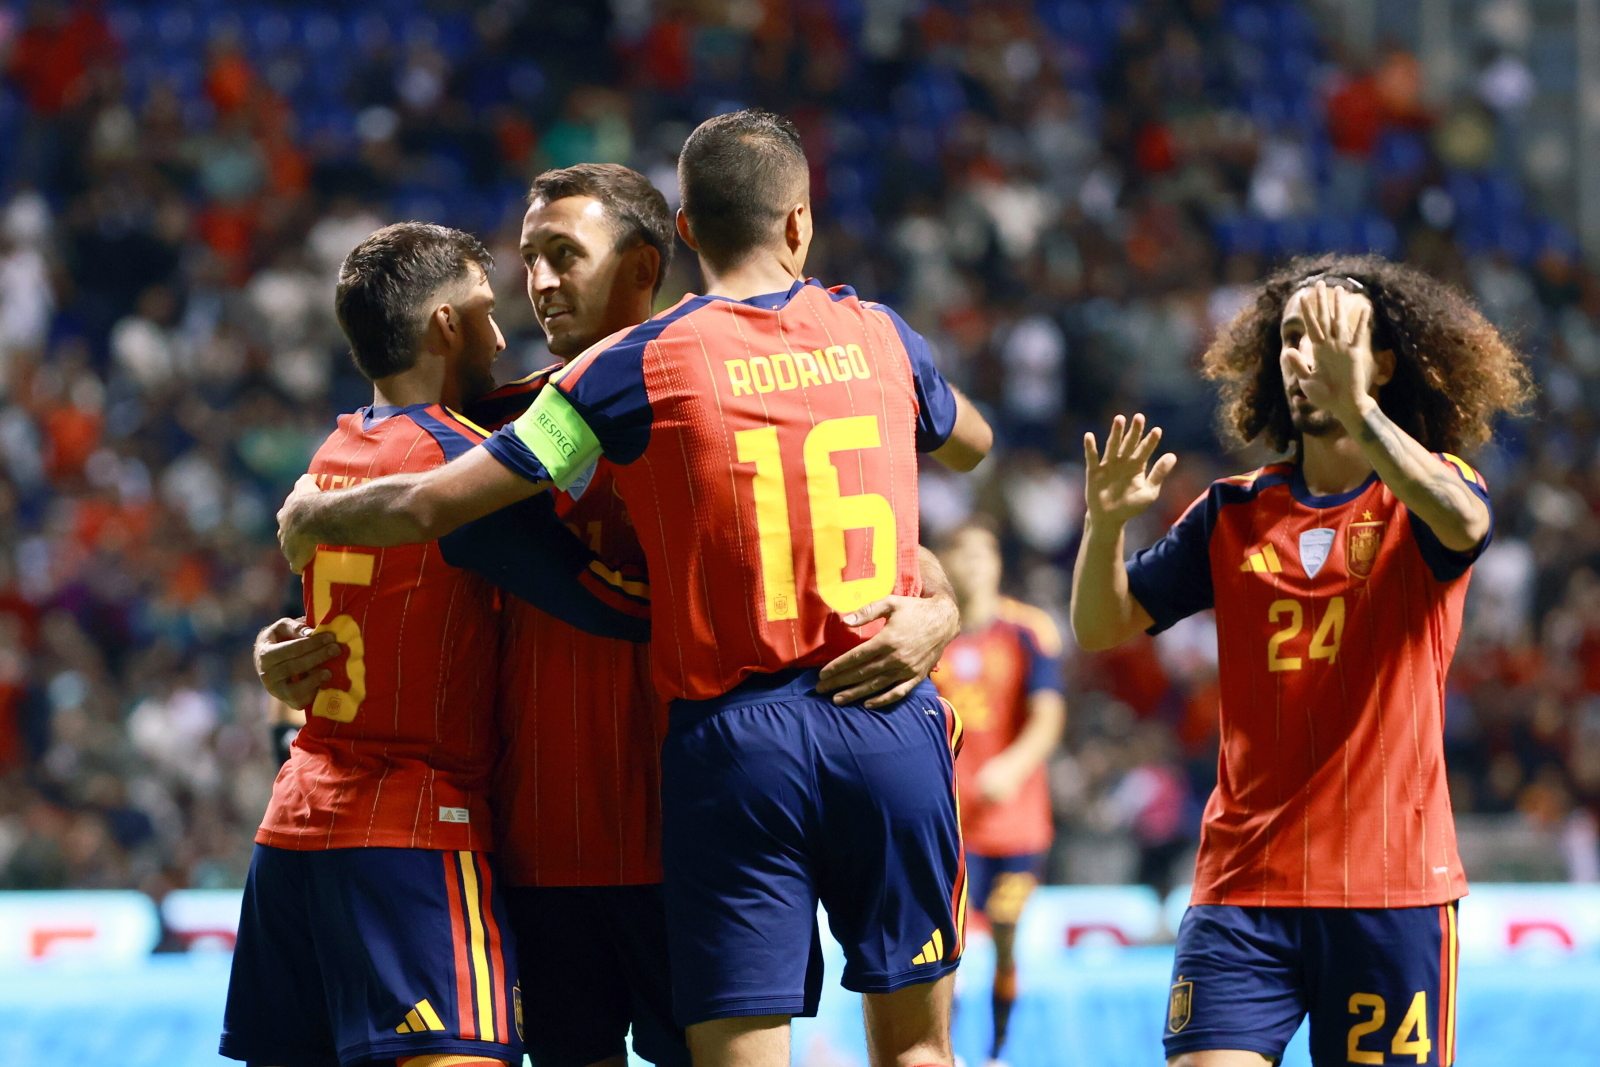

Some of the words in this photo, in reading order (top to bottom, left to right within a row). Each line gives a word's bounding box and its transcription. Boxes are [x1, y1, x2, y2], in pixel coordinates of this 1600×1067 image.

[725, 343, 870, 397] RODRIGO
[537, 413, 577, 458] RESPECT
[734, 415, 897, 622] 16
[1268, 596, 1346, 672] 24
[1347, 990, 1432, 1065] 24
